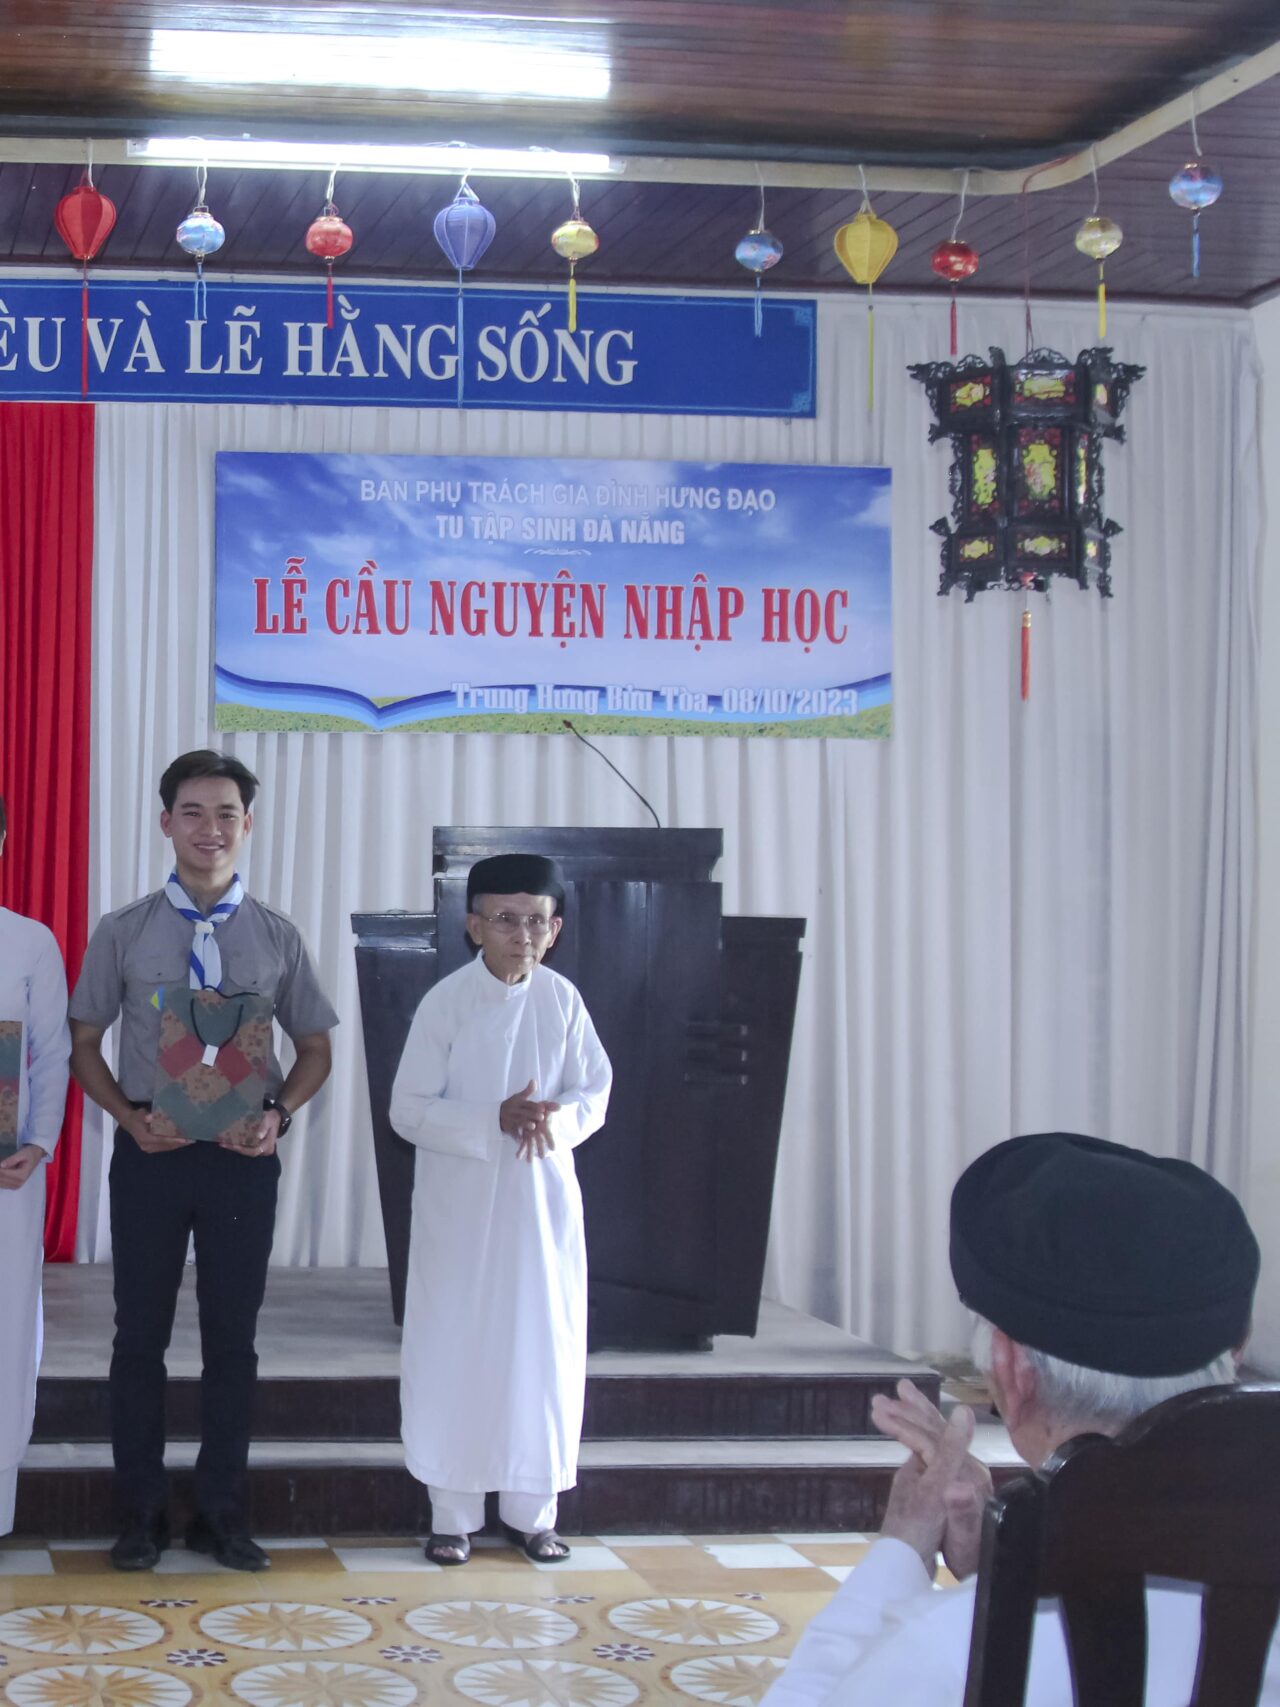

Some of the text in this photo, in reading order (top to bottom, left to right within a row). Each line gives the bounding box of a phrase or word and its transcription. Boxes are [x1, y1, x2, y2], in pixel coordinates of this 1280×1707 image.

[85, 300, 165, 373] VÀ
[184, 305, 263, 375] LẼ
[282, 295, 460, 381] HẰNG
[477, 302, 637, 386] SỐNG
[361, 478, 776, 516] BAN PHỤ TRÁCH GIA ĐÌNH HƯNG ĐẠO
[436, 512, 685, 545] TU TẬP SINH ĐÀ NẴNG
[253, 556, 849, 653] LỄ CẦU NGUYỆN NHẬP HỌC
[452, 683, 531, 714] Trung
[723, 687, 859, 715] 08/10/2023
